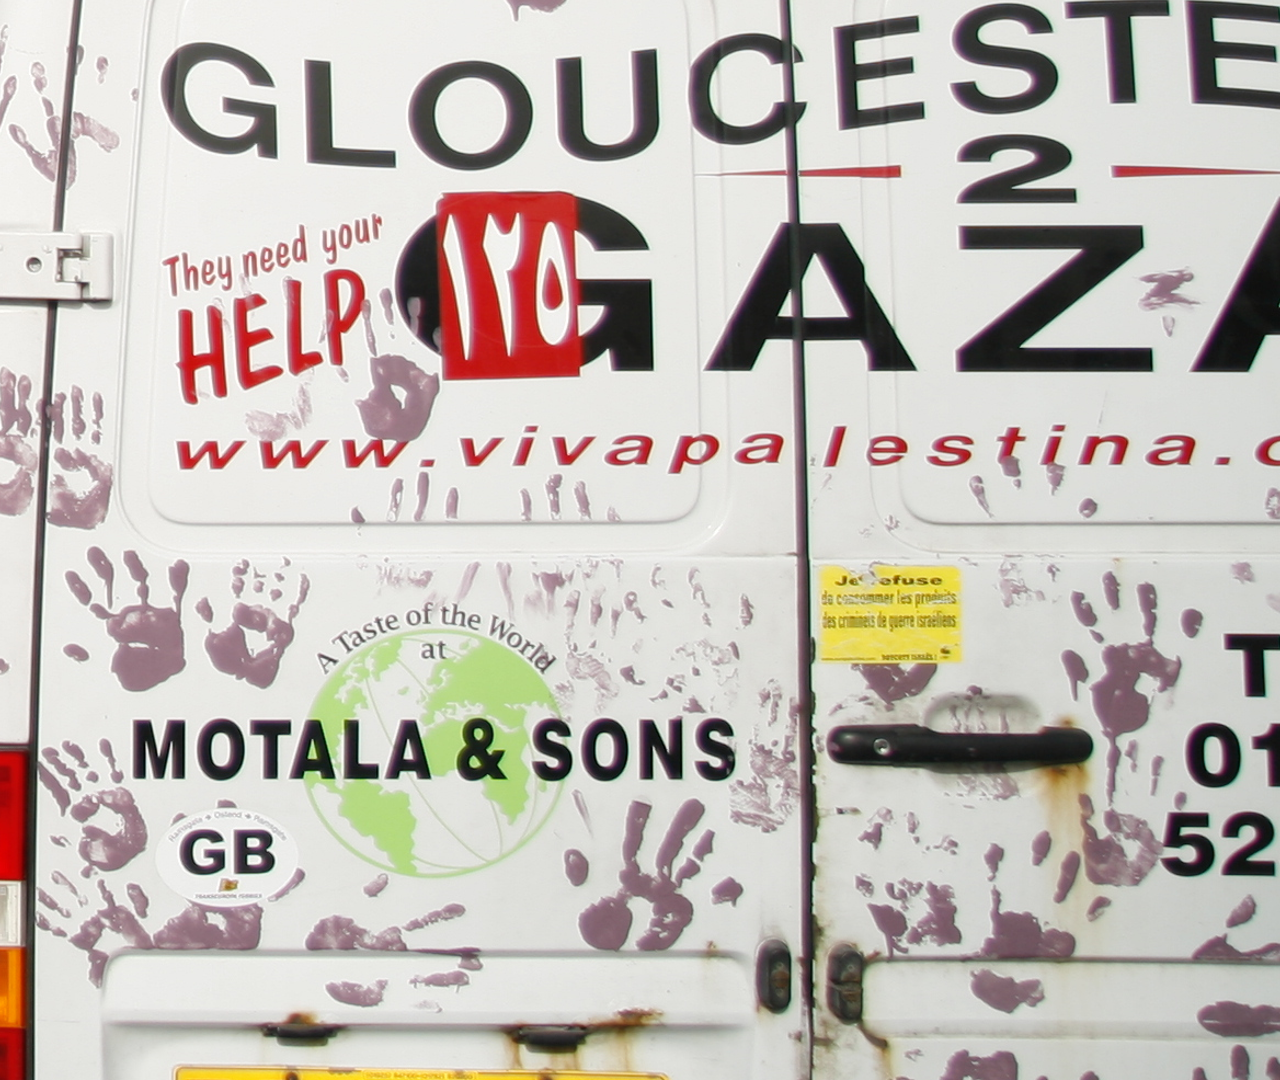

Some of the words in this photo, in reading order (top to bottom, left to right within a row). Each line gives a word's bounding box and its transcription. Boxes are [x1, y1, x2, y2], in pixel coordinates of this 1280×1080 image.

[956, 133, 1077, 204] 2
[162, 252, 232, 297] They
[243, 224, 307, 277] need
[322, 213, 383, 265] your
[175, 269, 365, 405] HELP
[872, 574, 942, 587] efuse
[316, 651, 338, 674] A
[332, 611, 400, 655] Taste
[406, 602, 433, 626] of
[441, 603, 481, 631] the
[490, 614, 557, 674] World
[421, 640, 450, 660] at
[132, 718, 430, 781] MOTALA
[456, 718, 507, 782] &
[532, 718, 736, 782] SONS
[179, 828, 275, 875] GB
